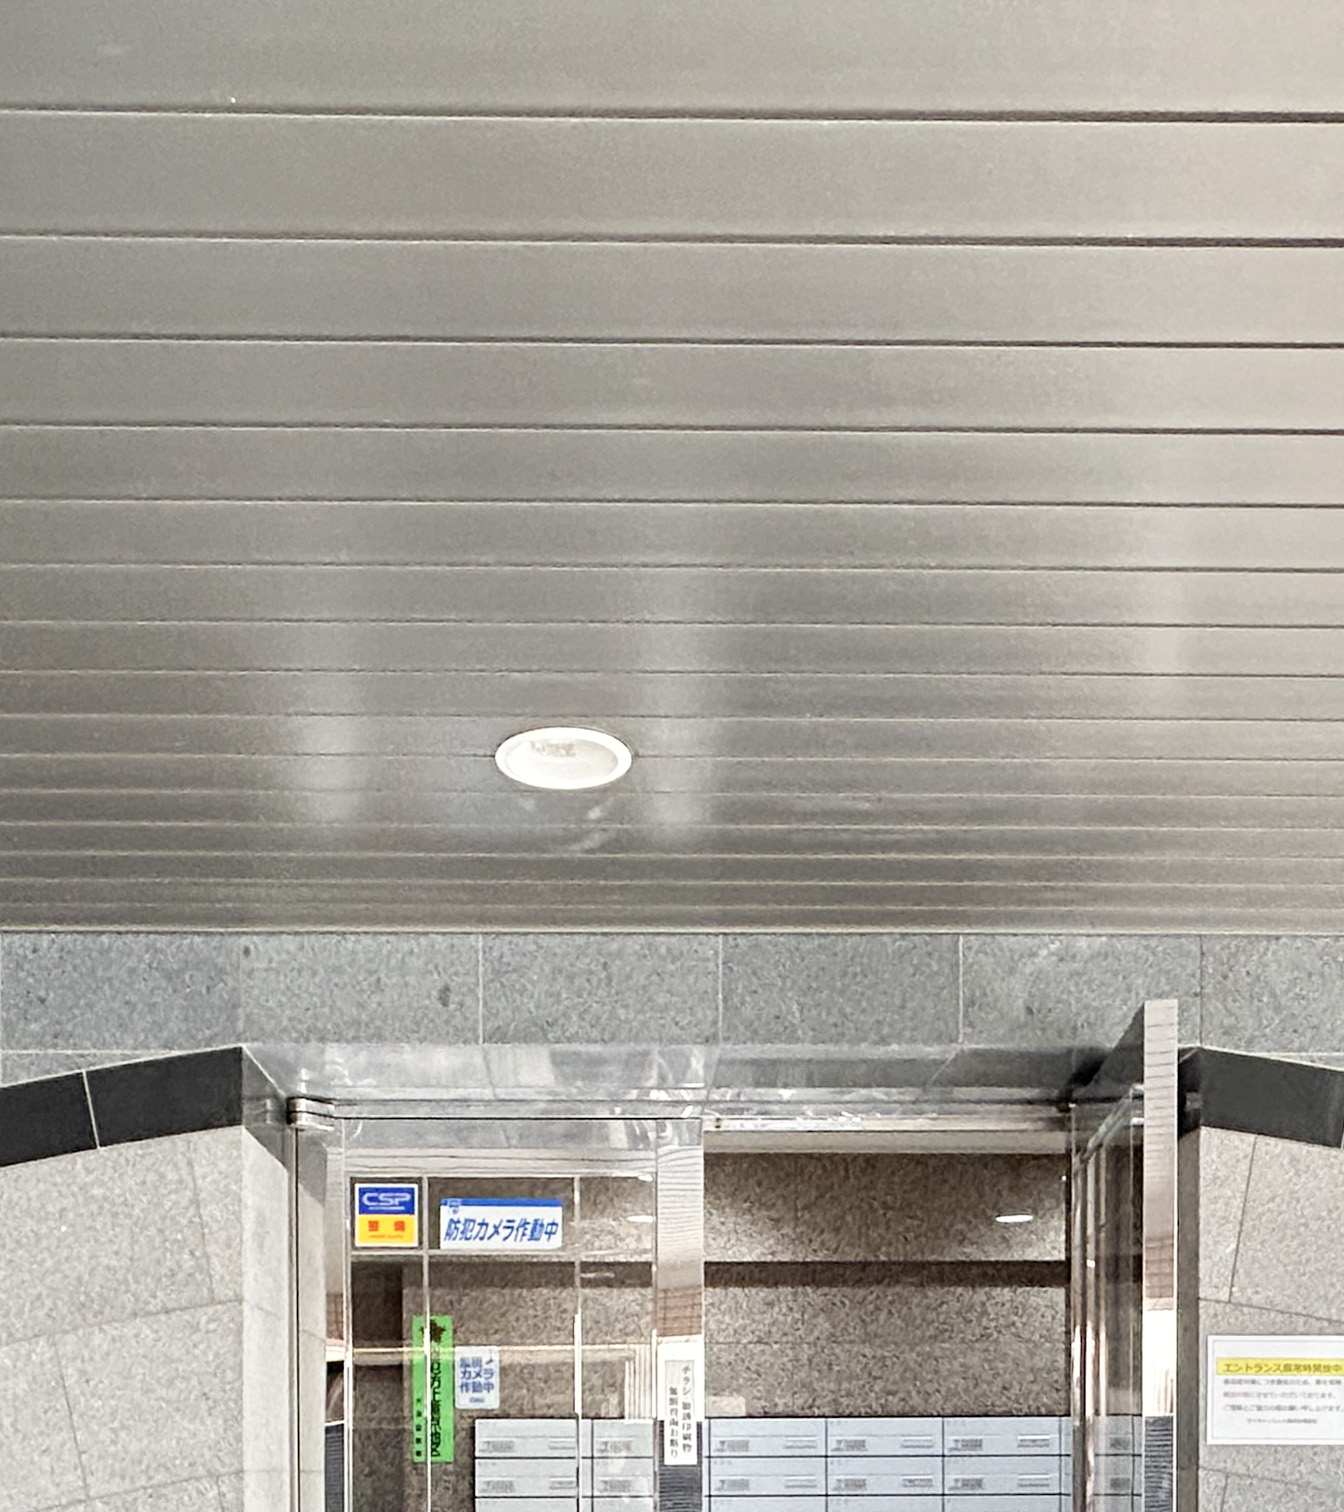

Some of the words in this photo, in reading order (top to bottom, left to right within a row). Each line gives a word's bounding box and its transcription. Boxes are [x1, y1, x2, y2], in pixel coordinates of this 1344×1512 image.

[361, 1192, 412, 1206] CSP
[444, 1217, 559, 1242] 防犯カメラ作動中
[460, 1368, 495, 1381] カメラ
[459, 1381, 495, 1394] 作動中
